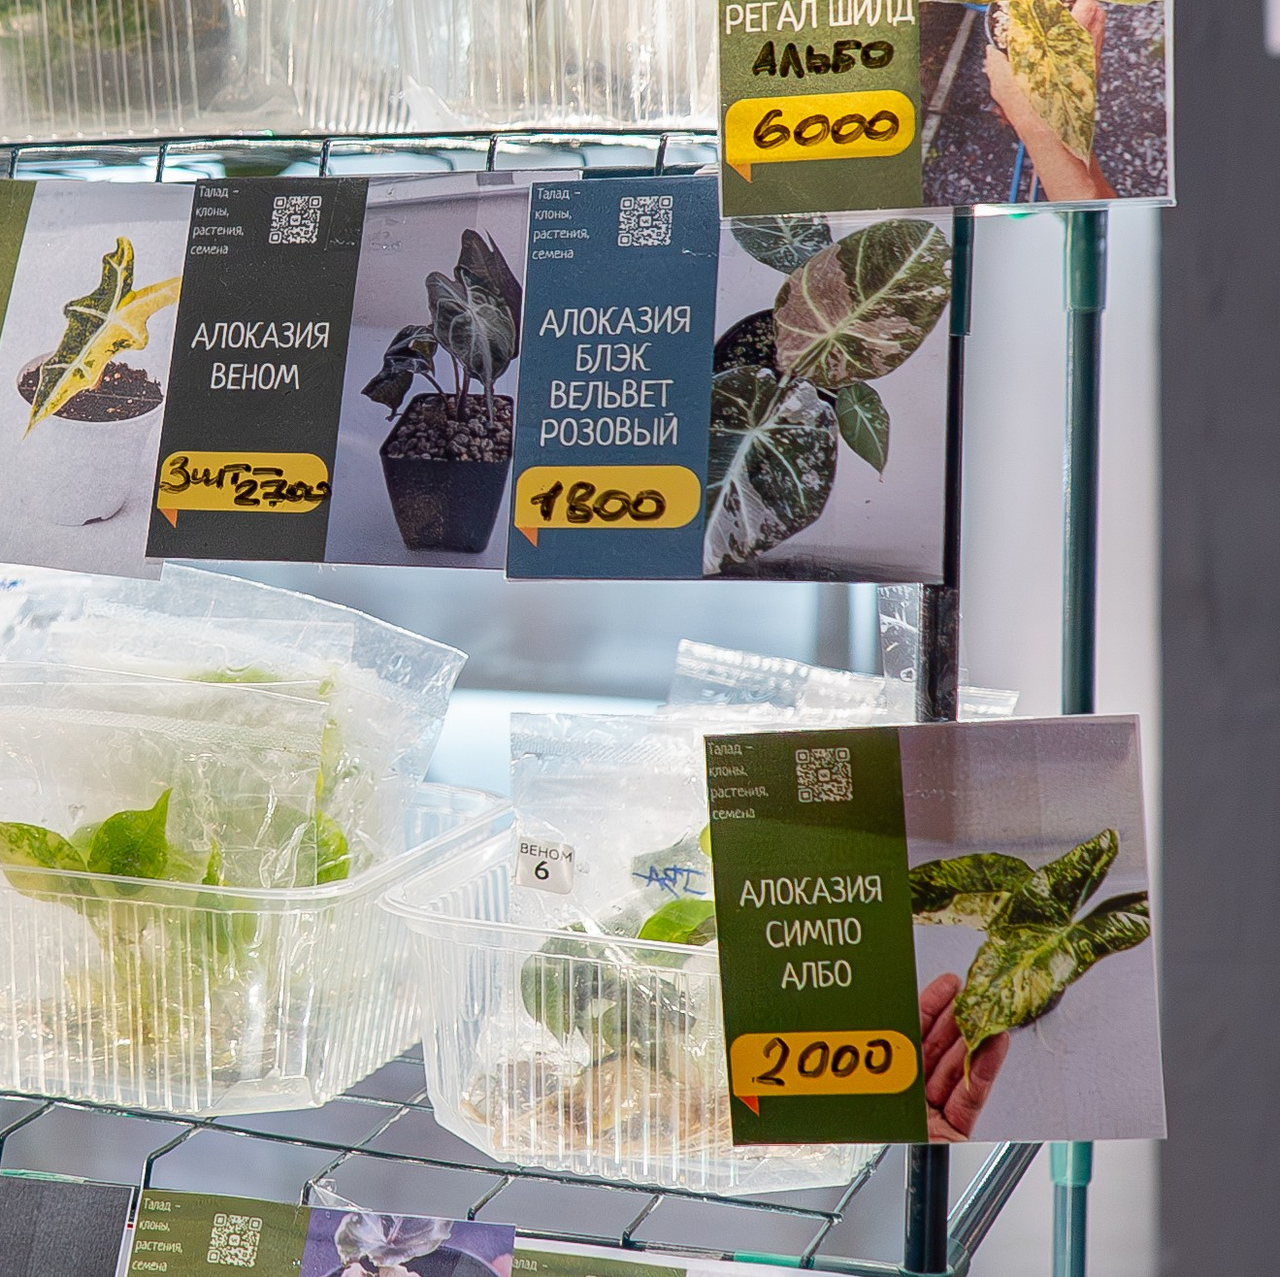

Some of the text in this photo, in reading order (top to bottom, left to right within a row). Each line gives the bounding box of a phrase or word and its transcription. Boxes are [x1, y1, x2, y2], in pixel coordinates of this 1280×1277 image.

[752, 39, 894, 79] АЛЬБО
[753, 108, 900, 149] 6000
[198, 185, 229, 199] Талад
[536, 186, 571, 202] Талад
[195, 205, 230, 218] клоны,
[535, 208, 572, 222] клоны,
[192, 225, 245, 239] растения,
[533, 228, 590, 244] растения,
[191, 244, 229, 256] семена
[531, 248, 574, 260] семена
[539, 306, 692, 337] АЛОКАЗИЯ
[191, 322, 330, 350] АЛОКАЗИЯ
[575, 342, 651, 372] БЛЭК
[210, 362, 300, 390] ВЕНОМ
[550, 379, 673, 411] ВЕЛЬВЕТ
[539, 412, 679, 448] РОЗОВЫЙ
[530, 480, 667, 524] 1800
[712, 807, 756, 819] семена
[520, 842, 573, 863] ВЕНОМ
[534, 860, 550, 880] 6
[739, 875, 883, 908] АЛОКАЗИЯ
[765, 916, 862, 948] СИМПО
[780, 960, 852, 991] АЛБО
[751, 1036, 894, 1087] 2000
[143, 1197, 172, 1212] Талад
[134, 1239, 183, 1255] растения,
[132, 1260, 167, 1272] семена
[512, 1256, 538, 1272] алад
